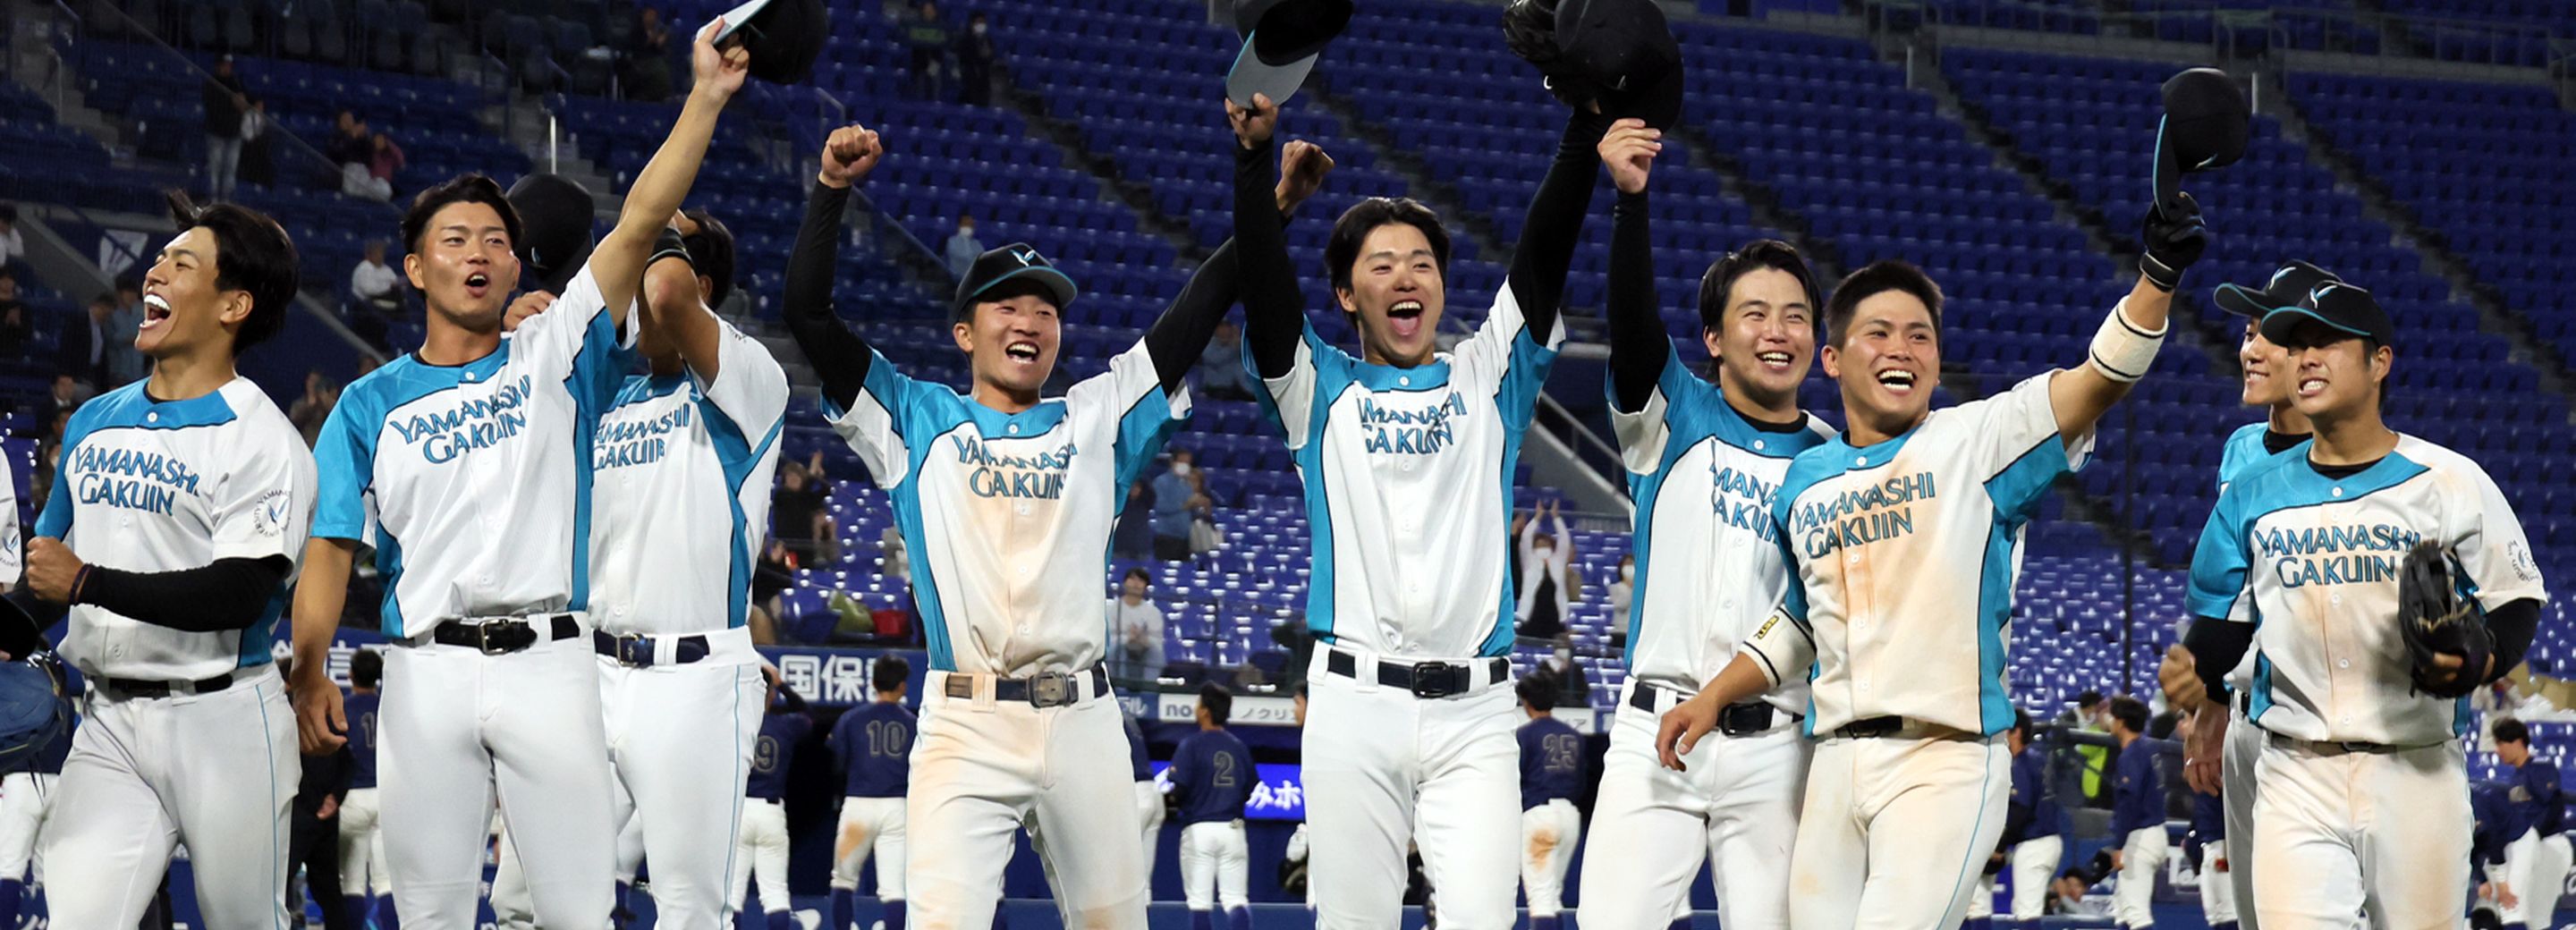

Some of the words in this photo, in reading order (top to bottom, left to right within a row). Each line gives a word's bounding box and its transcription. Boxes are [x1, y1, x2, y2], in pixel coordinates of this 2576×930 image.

[79, 473, 175, 516] GAKUIN
[1794, 472, 1936, 535] YAMANASHI
[1805, 507, 1913, 559] GAKUIN
[2275, 554, 2395, 588] GAKUIN
[779, 654, 909, 703] 国保
[1240, 707, 1296, 720] ノクリ
[866, 719, 907, 757] 10
[1542, 733, 1579, 770] 25
[1213, 750, 1235, 787] 2
